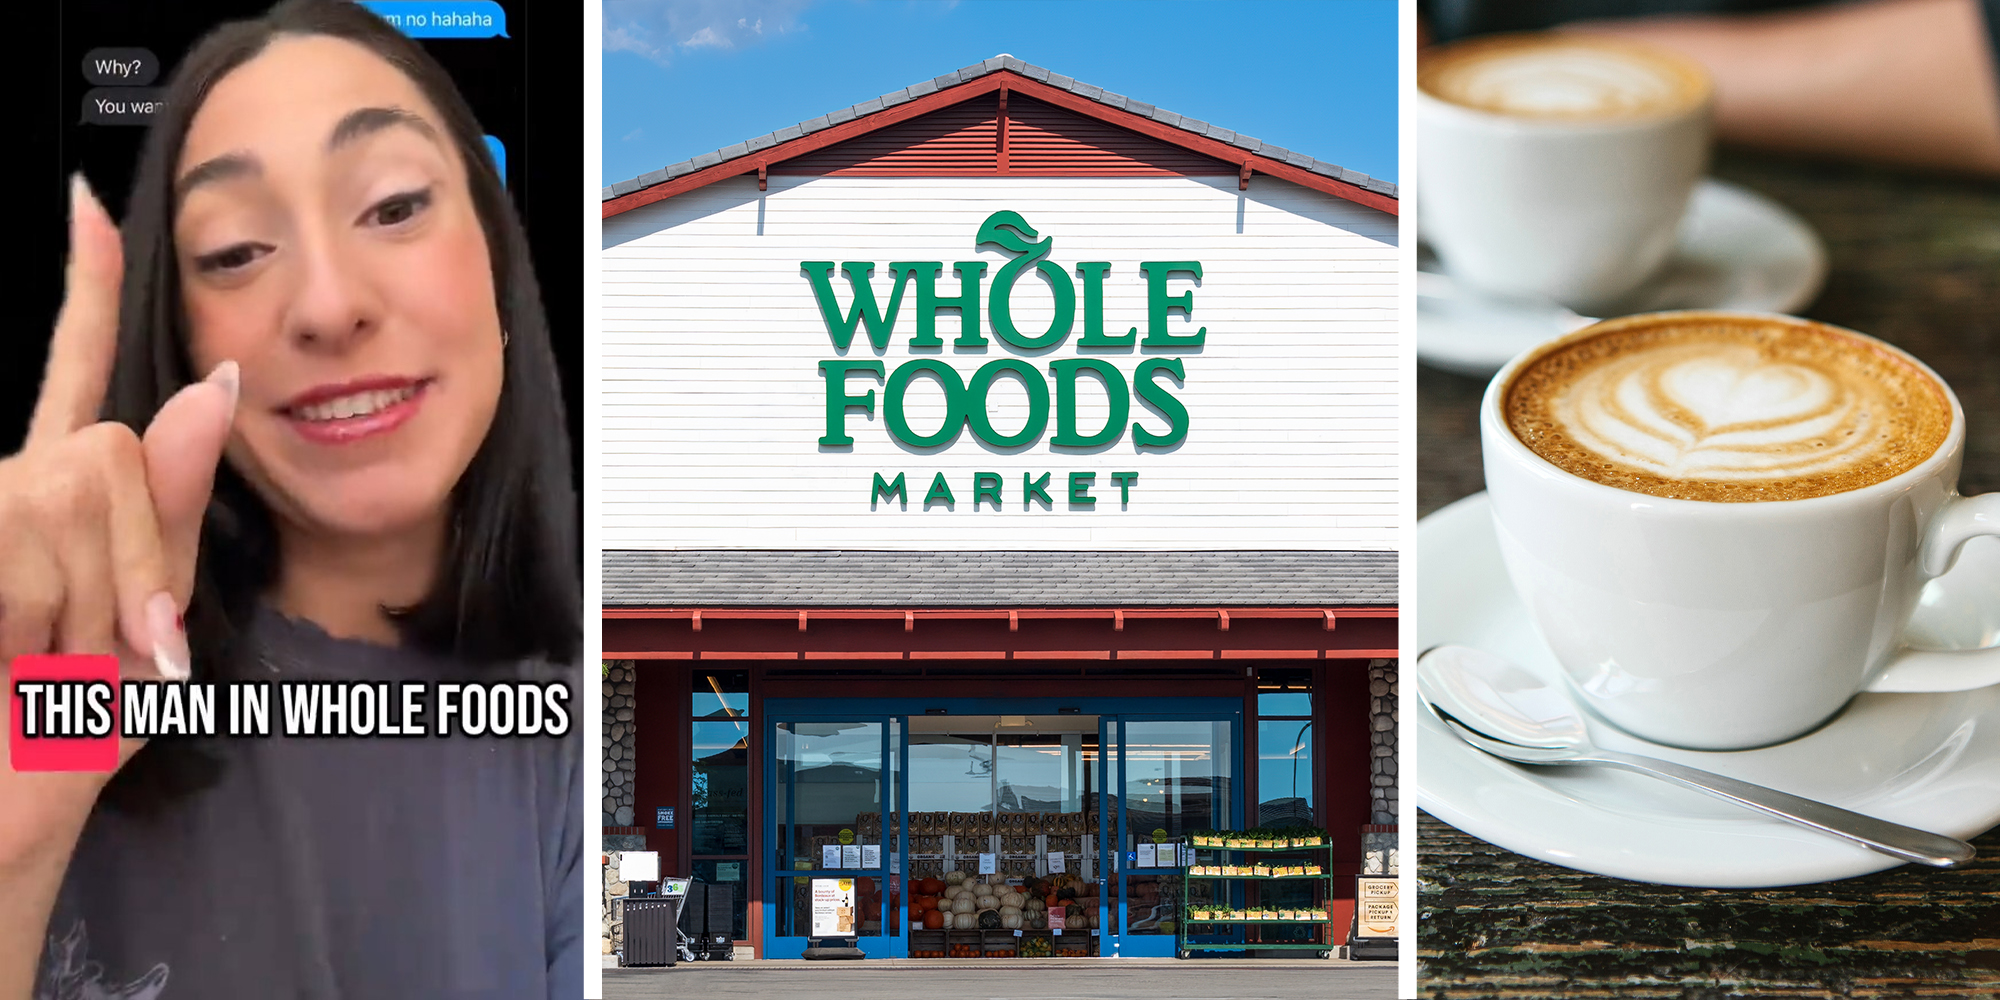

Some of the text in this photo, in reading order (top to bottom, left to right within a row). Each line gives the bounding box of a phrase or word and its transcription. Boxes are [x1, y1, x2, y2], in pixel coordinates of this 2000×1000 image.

[406, 14, 427, 27] no
[431, 11, 493, 27] hahaha
[95, 58, 142, 78] Why?
[95, 98, 164, 114] You wan
[800, 254, 1207, 349] WHOLE
[818, 357, 1190, 447] FOODS
[871, 471, 1139, 504] MARKET
[667, 883, 684, 893] 365
